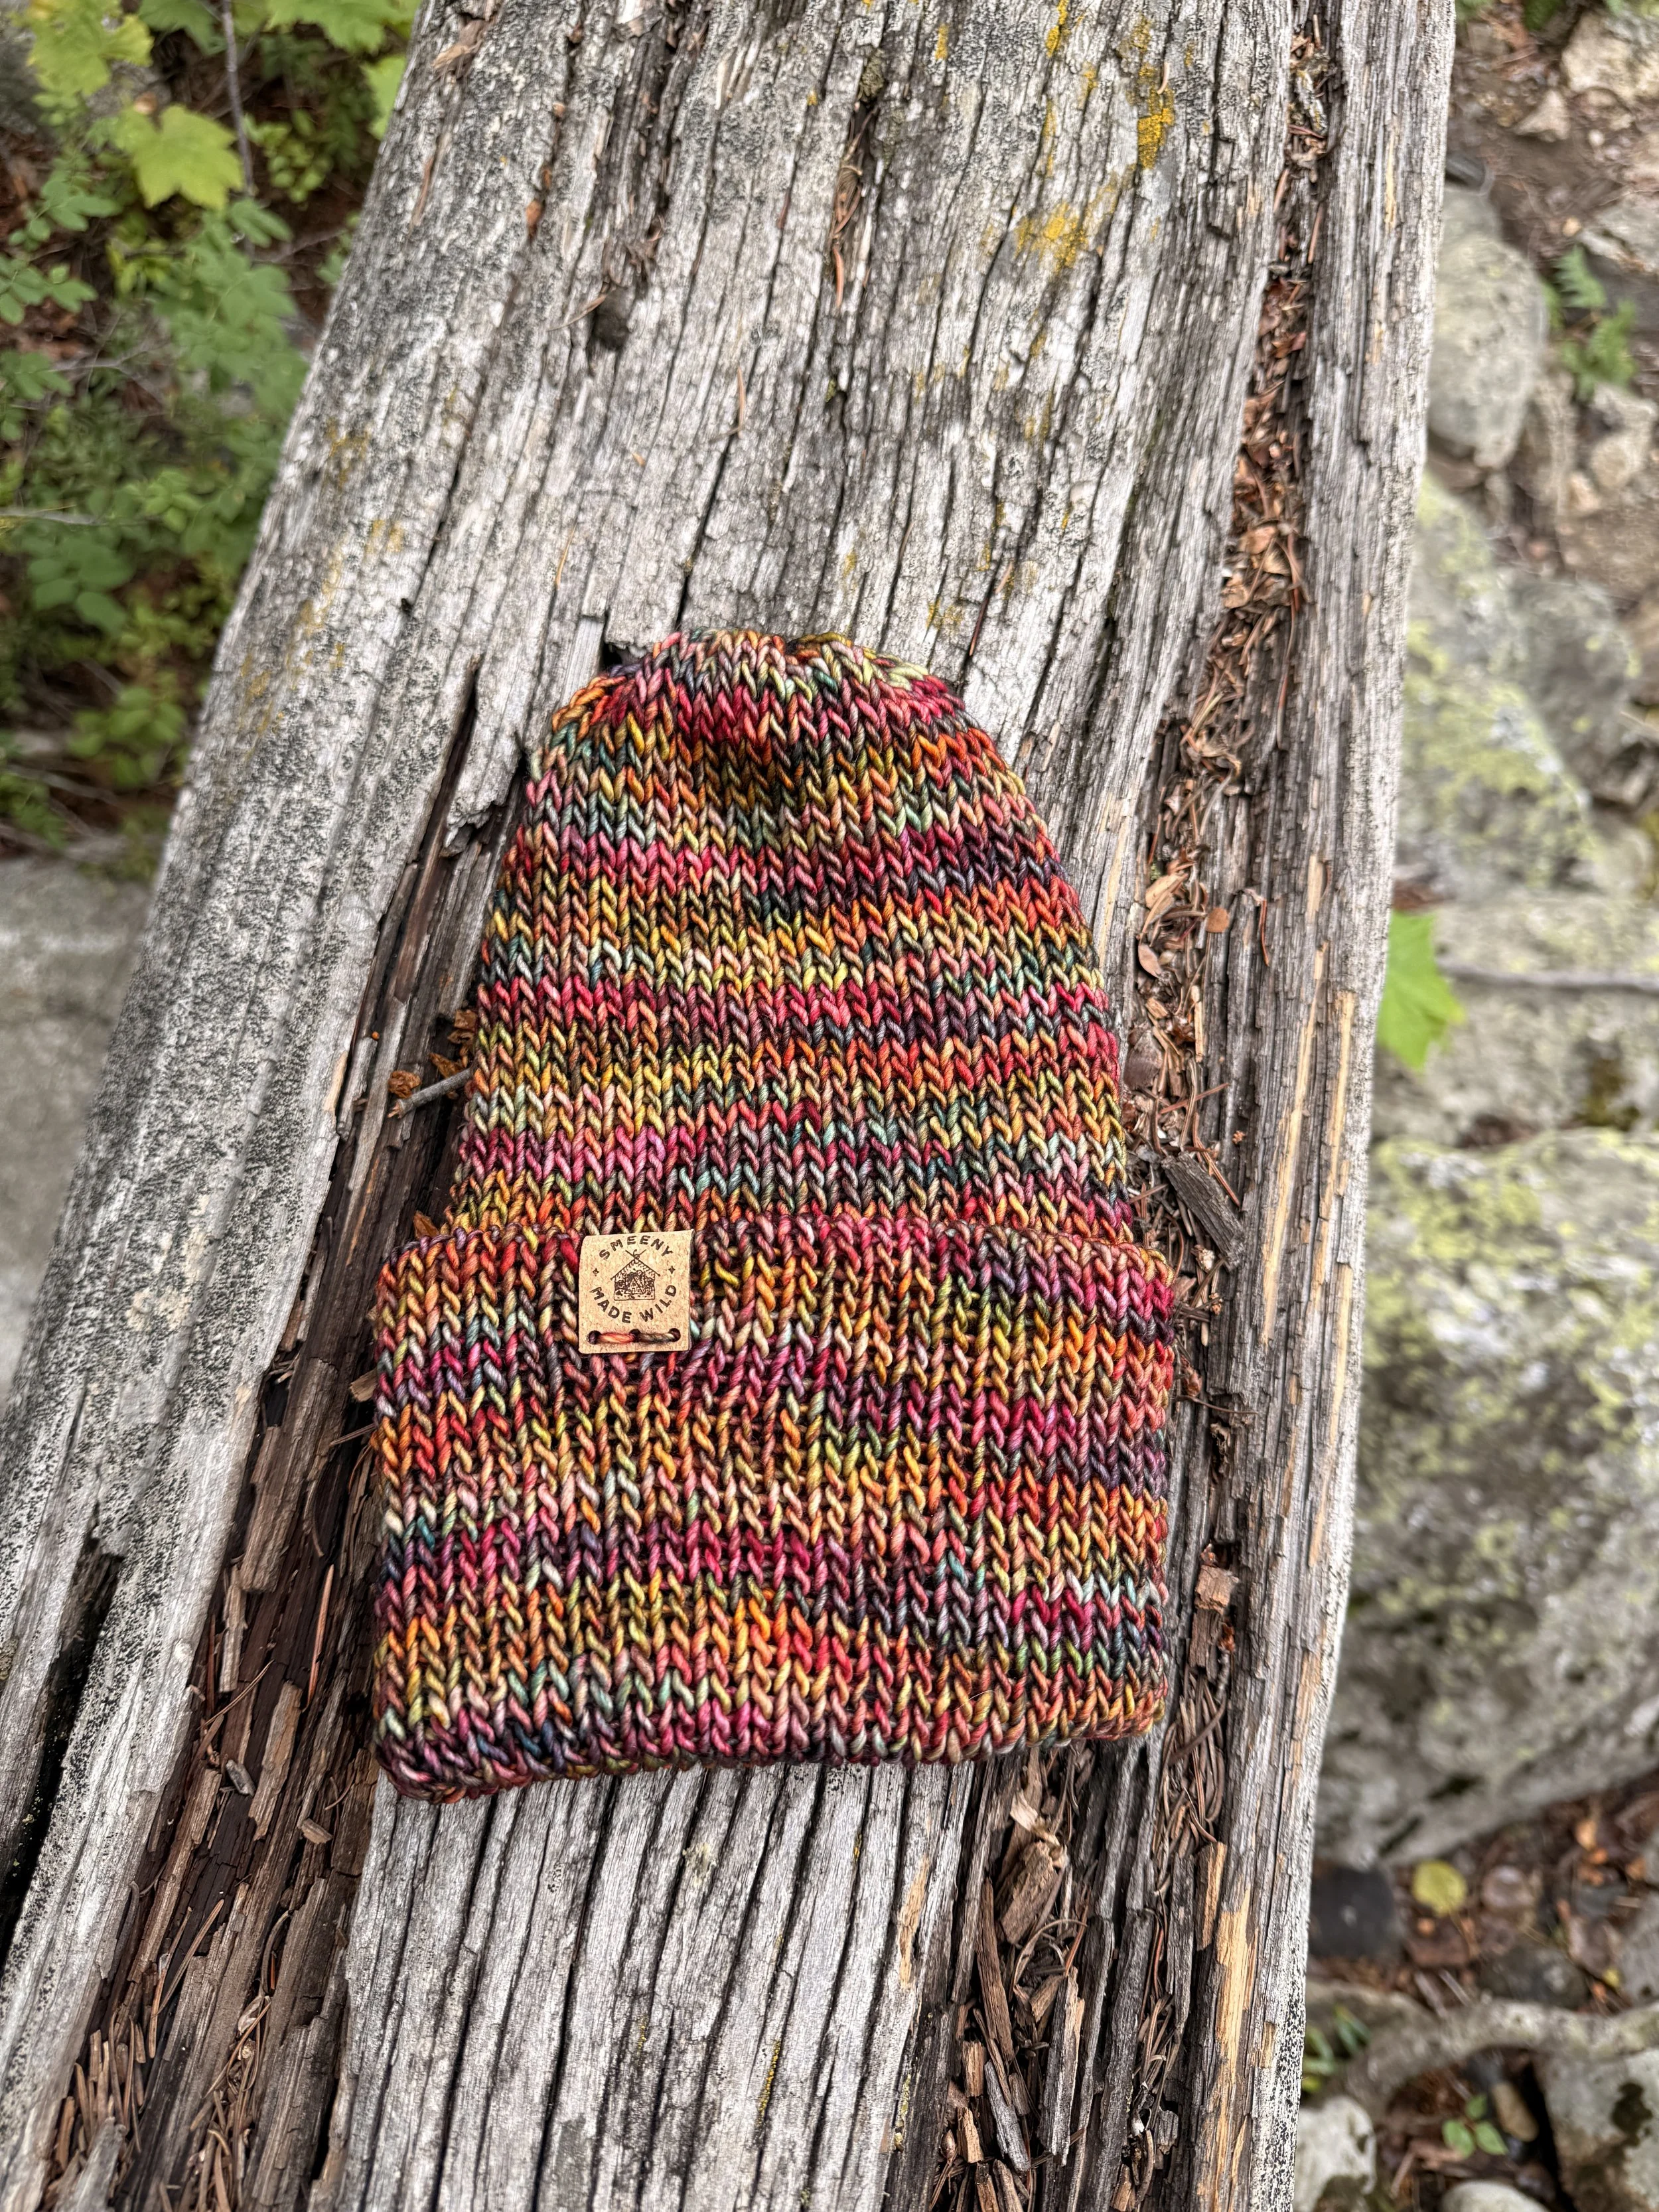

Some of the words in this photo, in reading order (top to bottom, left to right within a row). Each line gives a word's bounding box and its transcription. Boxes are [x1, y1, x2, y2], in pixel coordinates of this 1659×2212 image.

[599, 1235, 673, 1260] SMEENY
[590, 1286, 632, 1323] MADE
[639, 1285, 677, 1322] WILD
